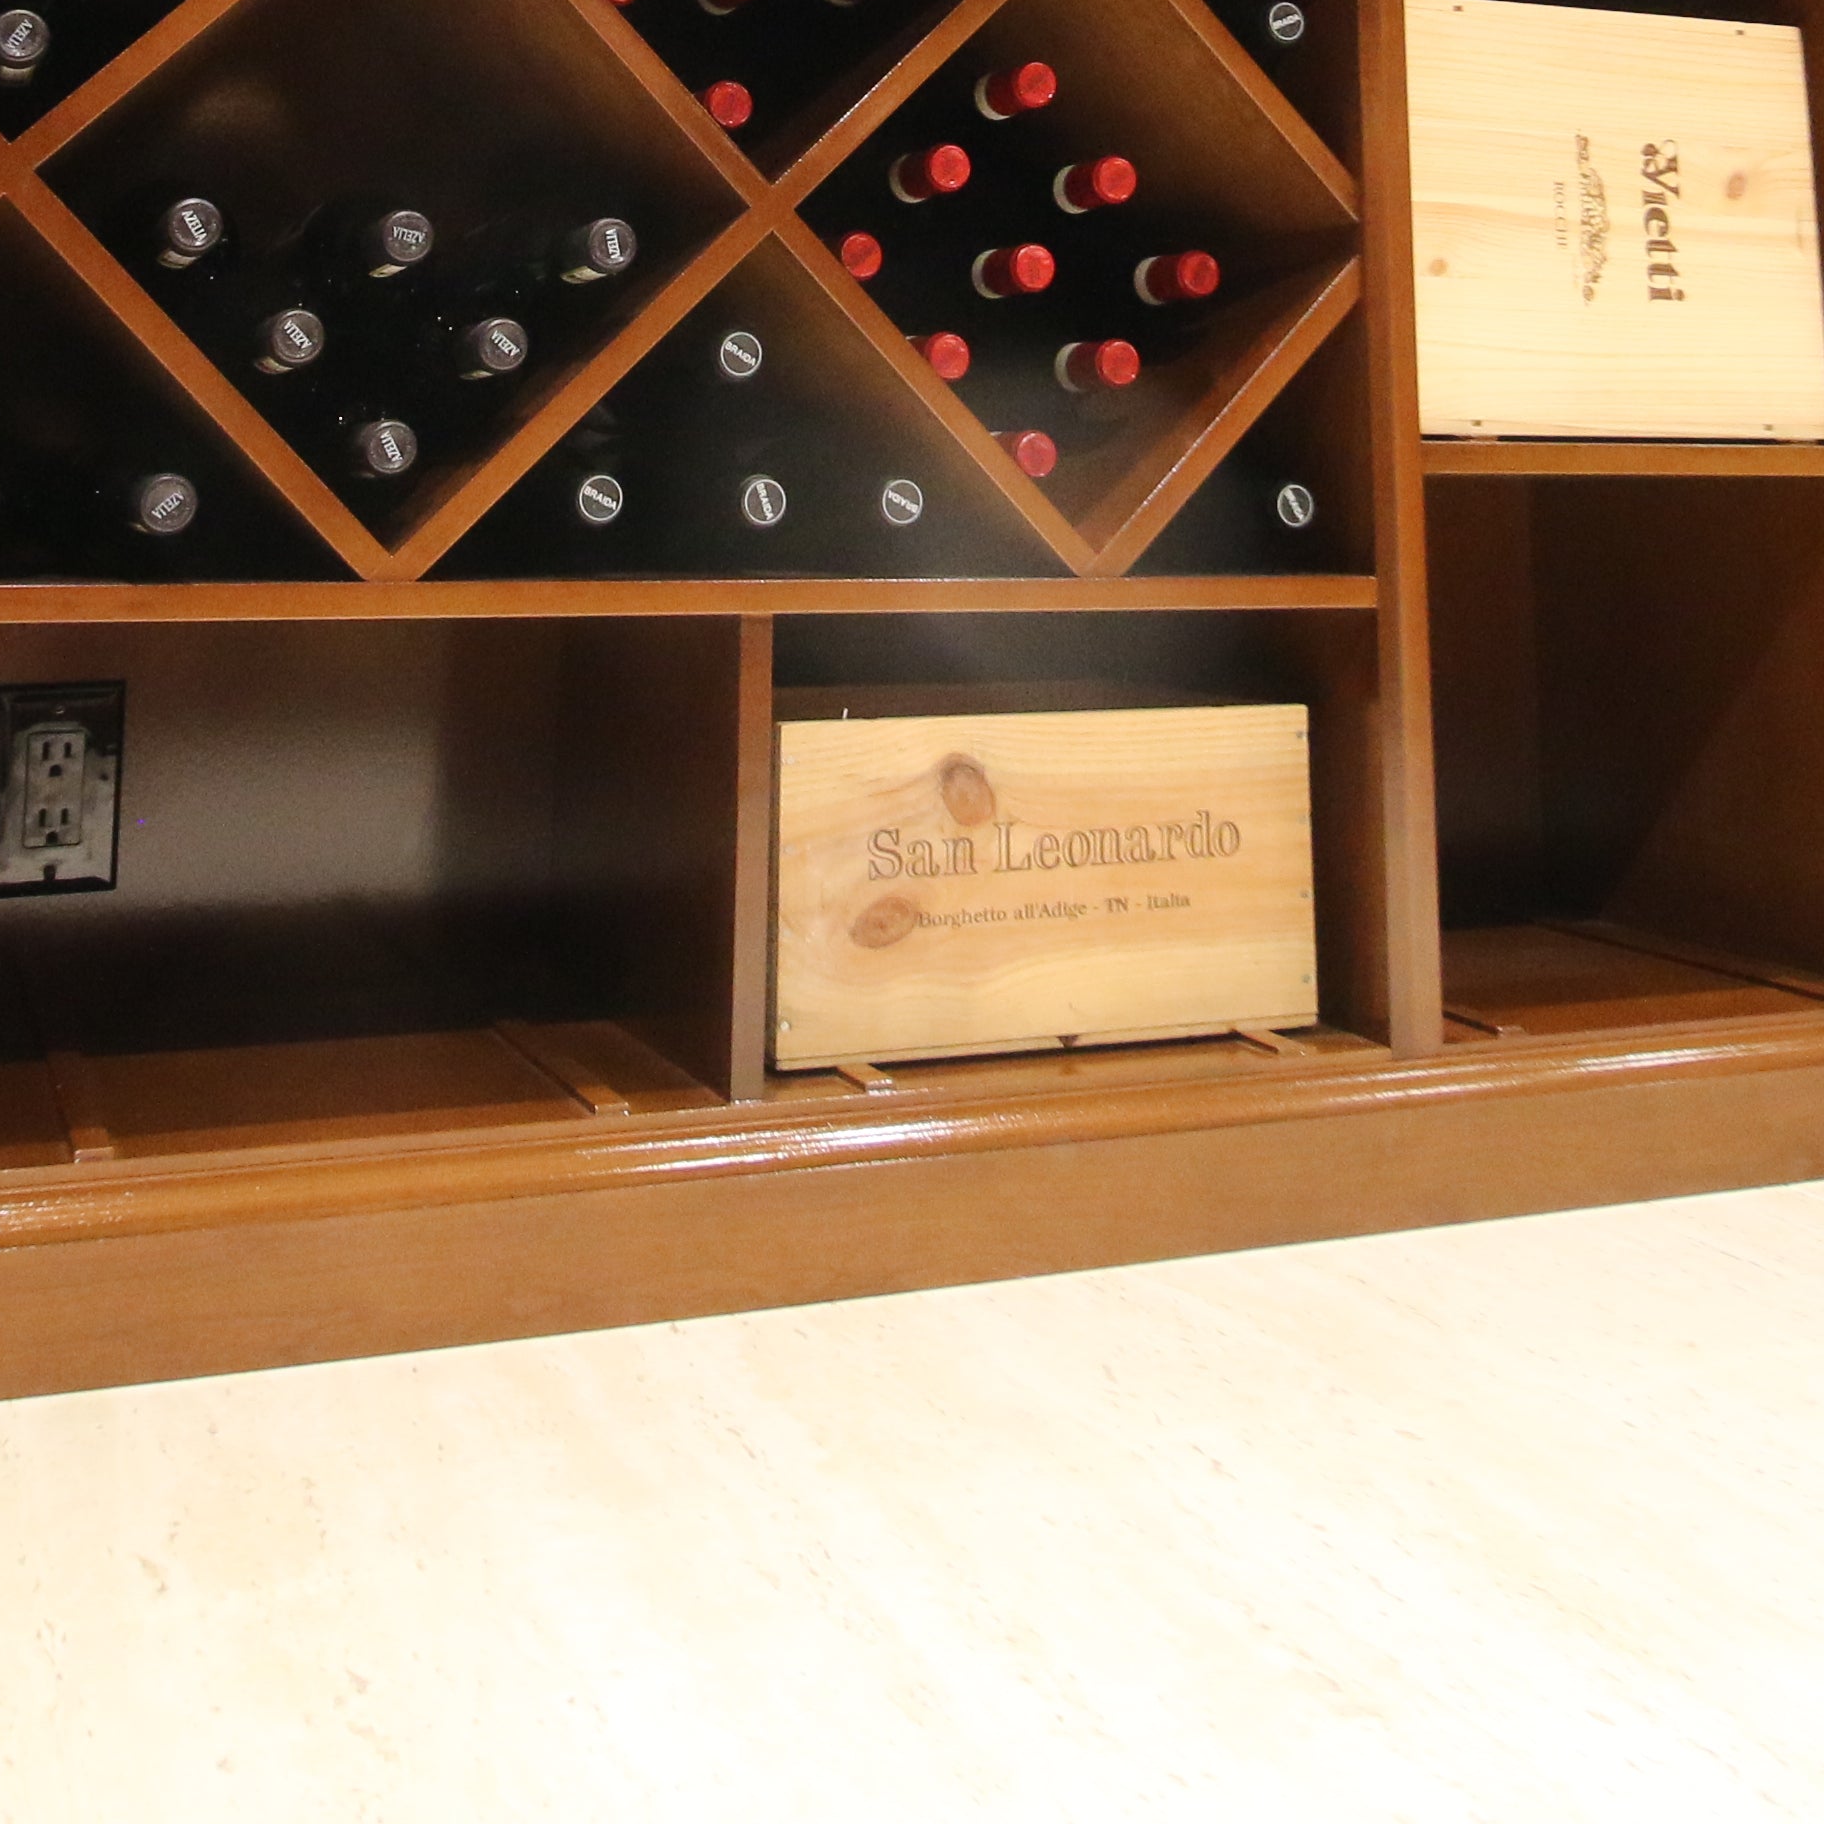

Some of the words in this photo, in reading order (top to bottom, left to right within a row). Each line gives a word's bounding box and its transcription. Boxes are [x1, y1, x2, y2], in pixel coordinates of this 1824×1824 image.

[6, 19, 33, 50] AZELIA
[181, 210, 208, 247] AZELIA
[1641, 139, 1685, 301] Vietti
[283, 319, 312, 349] AZELIA
[491, 331, 520, 356] AZELIA
[725, 341, 757, 366] BRAIDA
[380, 431, 404, 463] AZELIA
[151, 490, 184, 519] AZELIA
[583, 485, 617, 510] BRAIDA
[756, 482, 775, 521] BRAIDA
[867, 827, 978, 881] San
[993, 809, 1242, 873] Leonardo
[917, 909, 1007, 929] Borghetto
[1013, 902, 1088, 922] all'Adige
[1147, 892, 1192, 910] Italia
